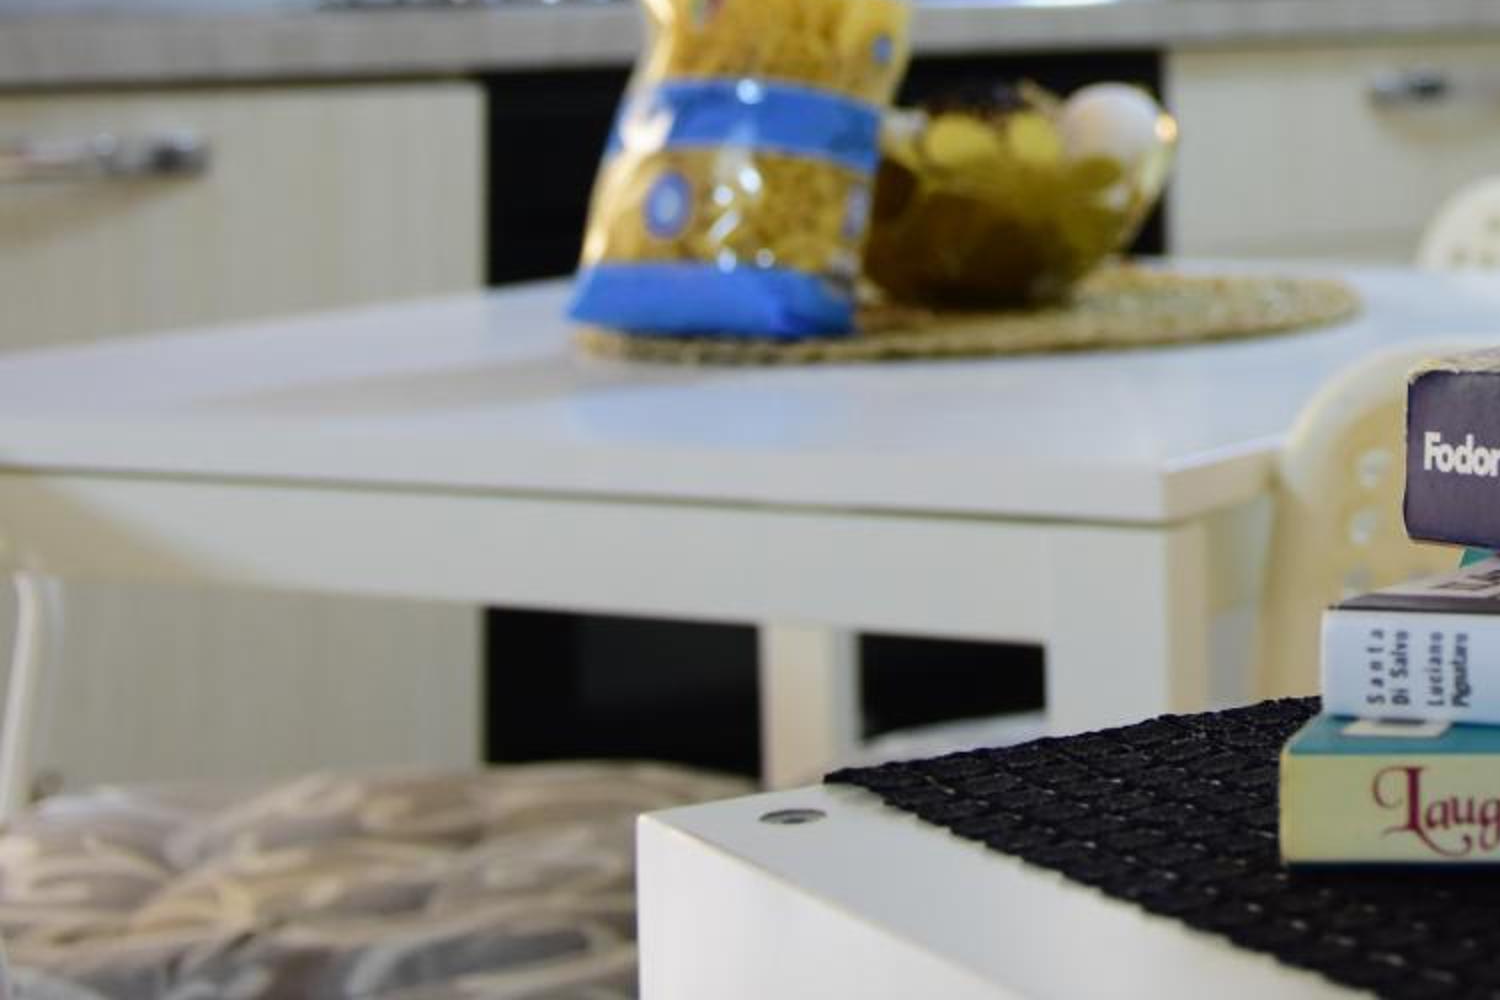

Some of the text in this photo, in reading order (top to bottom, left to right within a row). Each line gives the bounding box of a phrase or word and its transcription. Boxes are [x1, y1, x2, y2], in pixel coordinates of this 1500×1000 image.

[1366, 628, 1386, 706] Santa
[1390, 630, 1410, 679] Salvo
[1425, 630, 1445, 707] Luciano
